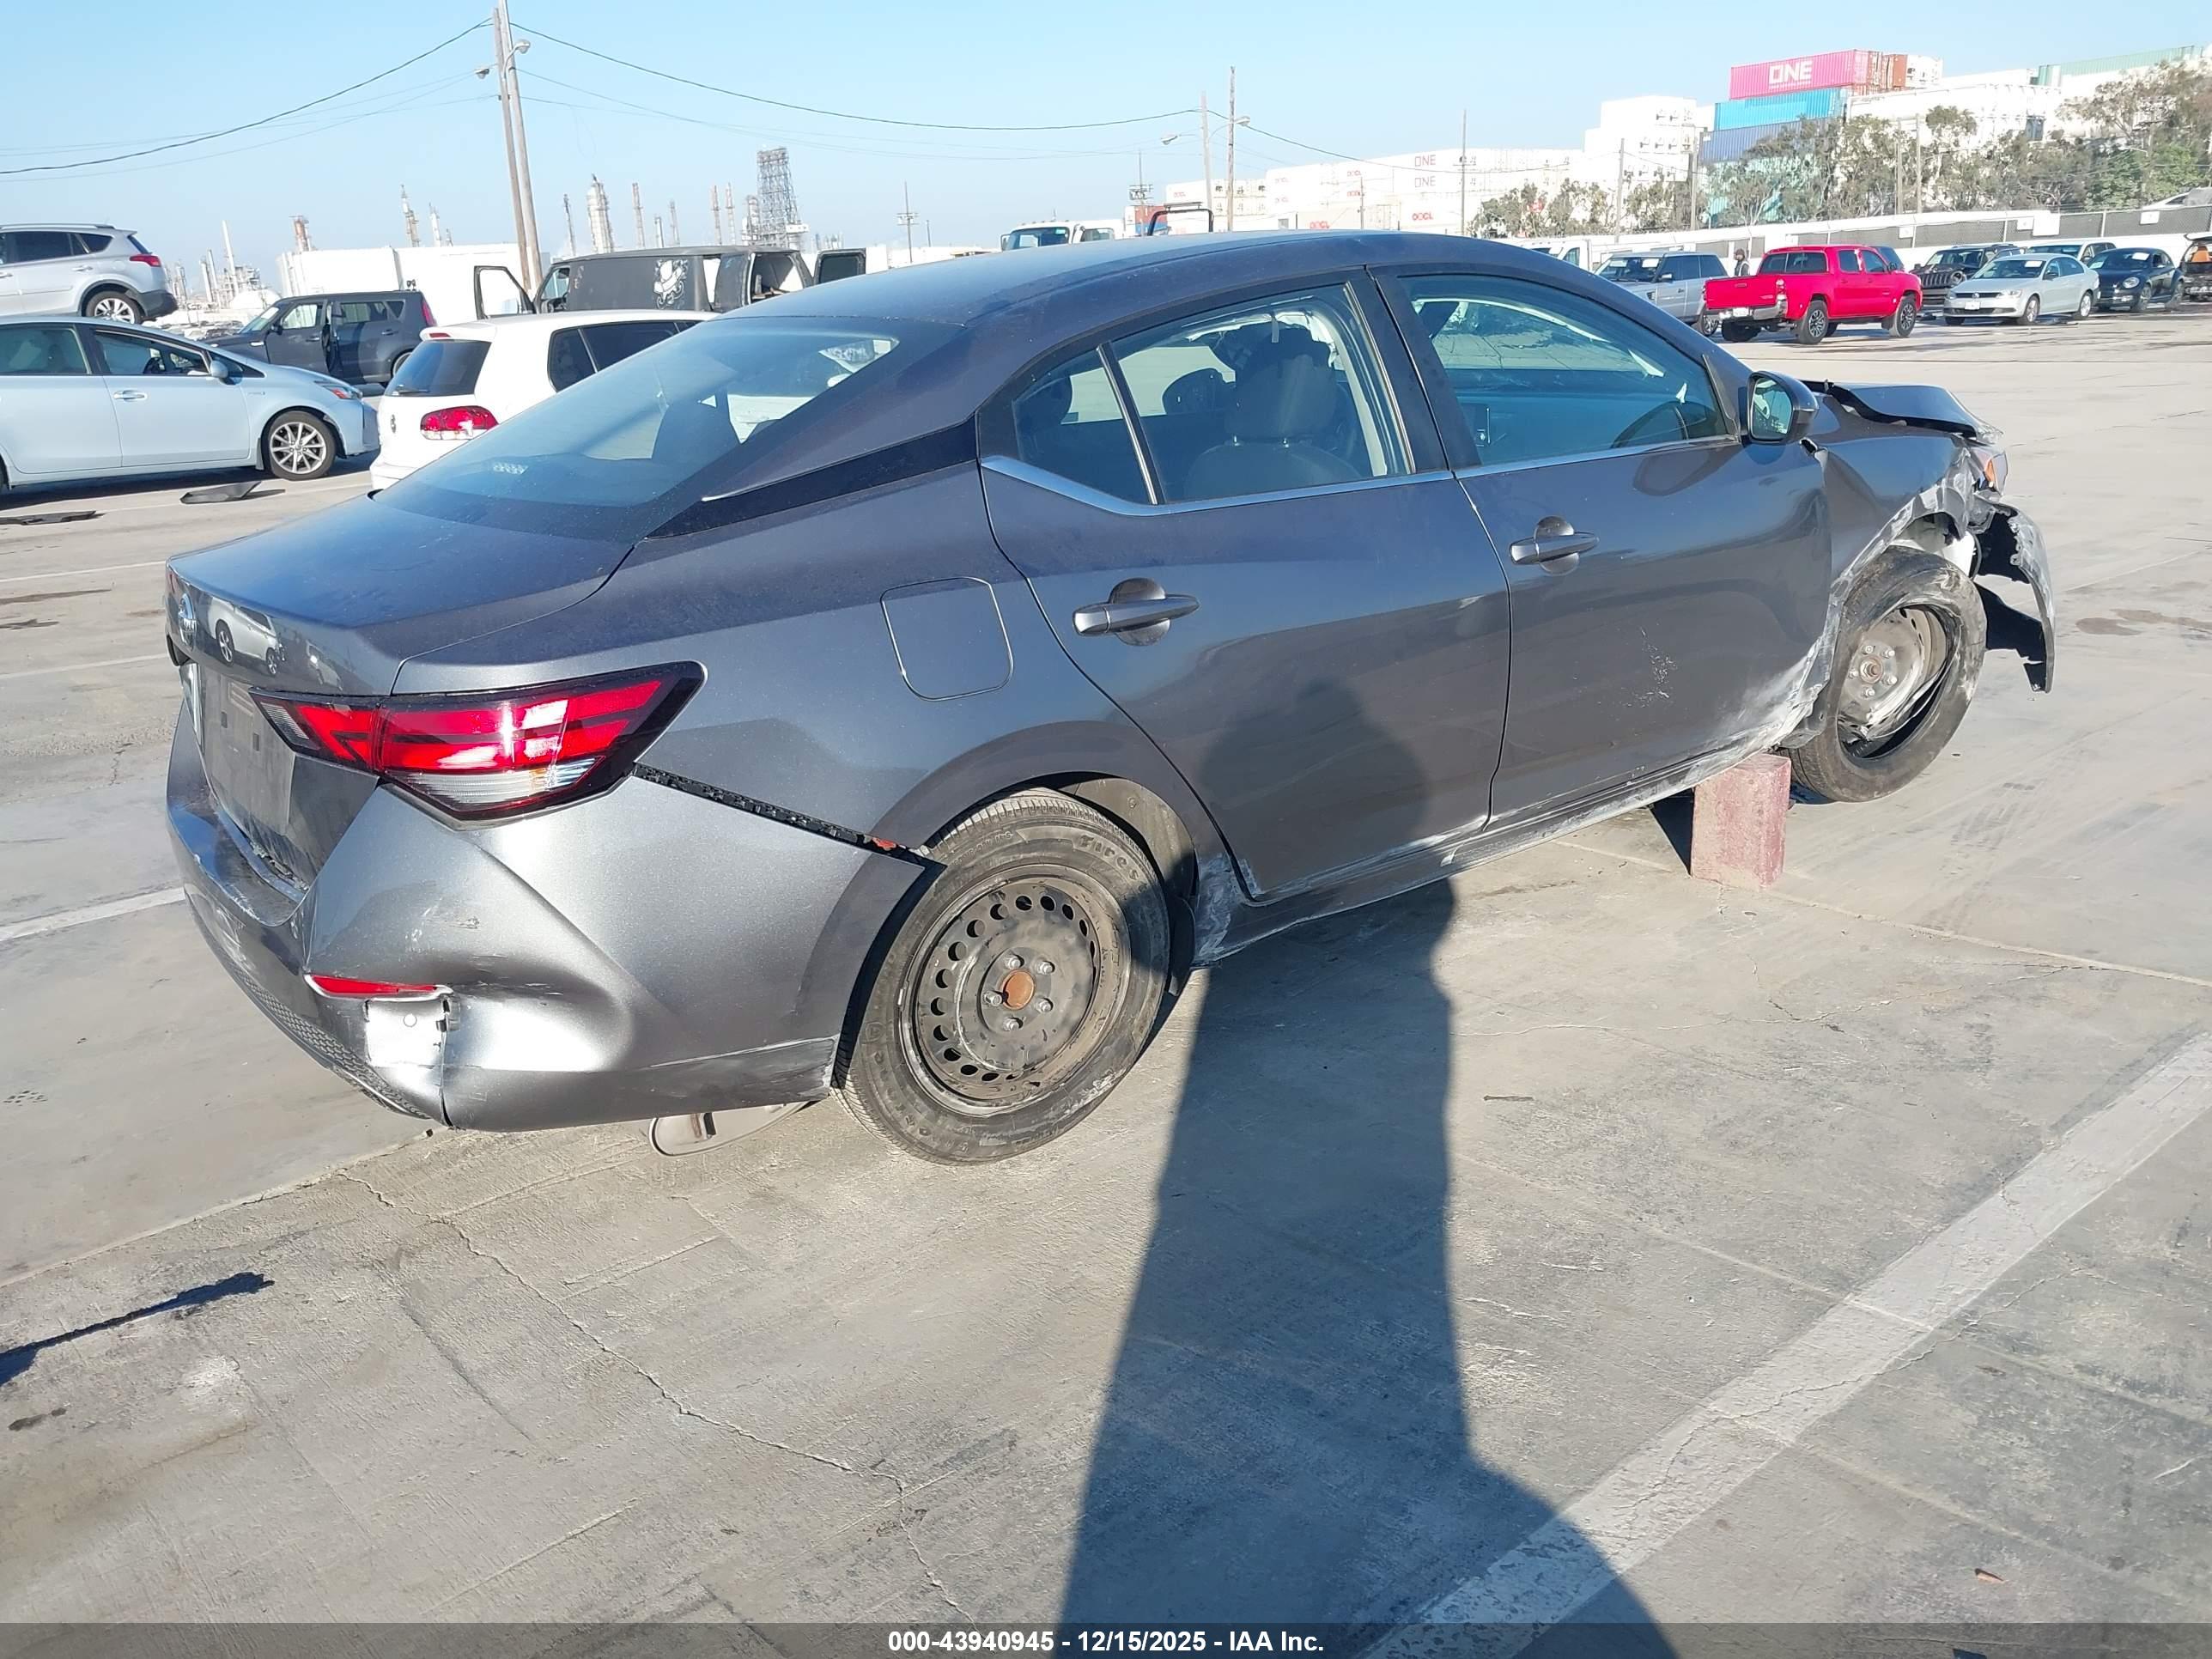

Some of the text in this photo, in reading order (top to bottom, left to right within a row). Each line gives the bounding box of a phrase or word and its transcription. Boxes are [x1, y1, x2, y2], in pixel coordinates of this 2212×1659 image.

[1769, 61, 1813, 84] ONE
[1415, 155, 1436, 167] ONE
[1415, 176, 1436, 187] ONE
